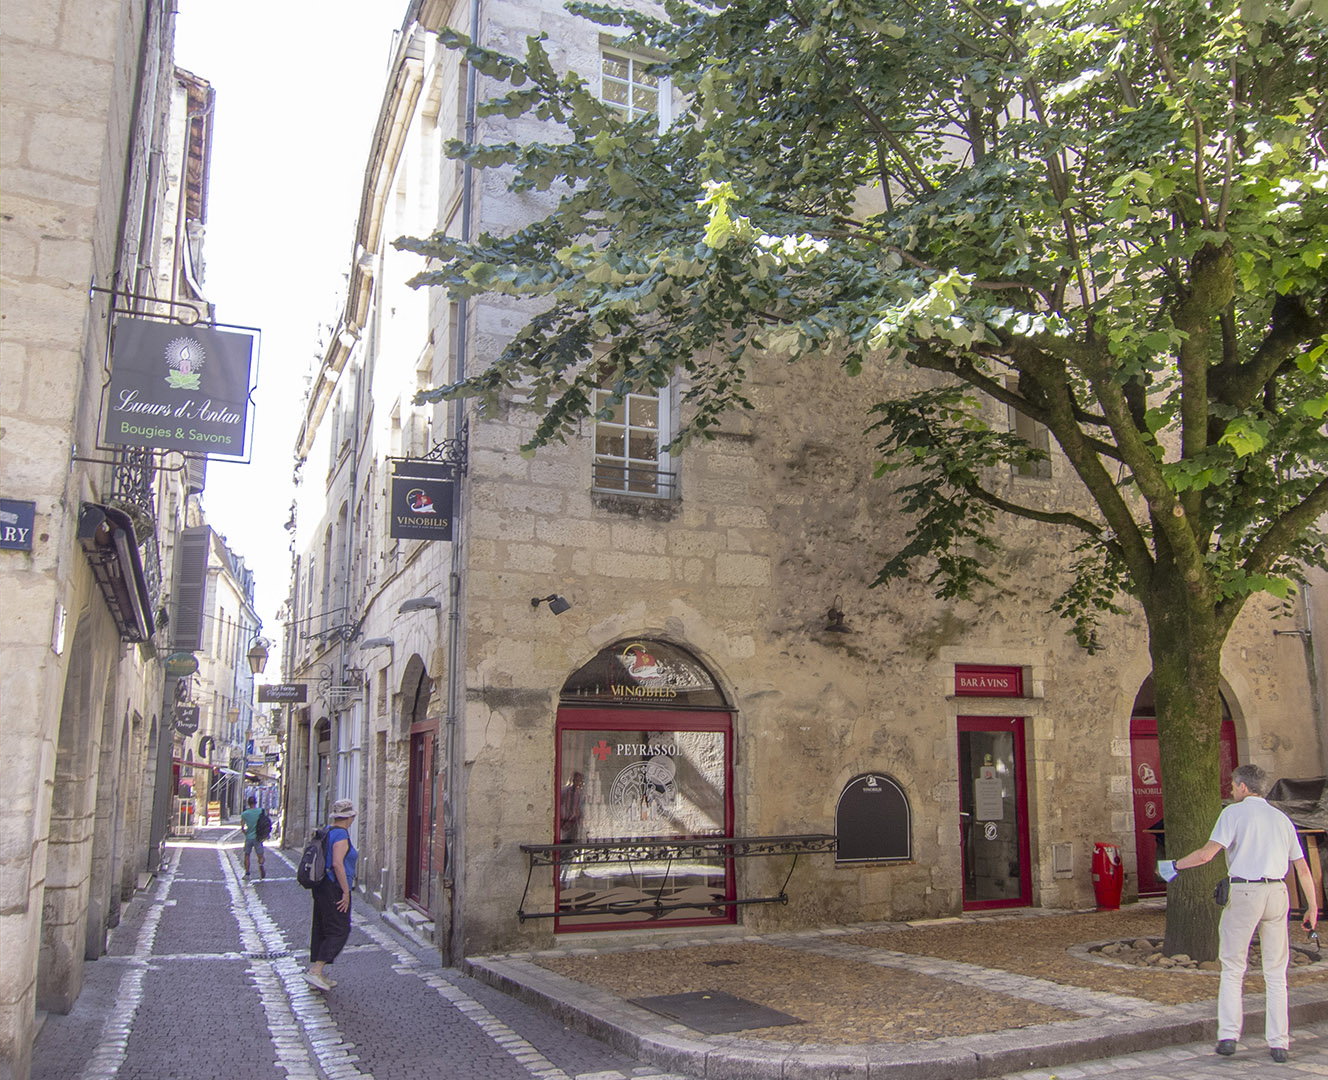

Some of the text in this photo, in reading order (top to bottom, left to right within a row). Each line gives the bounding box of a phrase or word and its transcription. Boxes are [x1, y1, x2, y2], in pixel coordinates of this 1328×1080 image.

[113, 389, 242, 424] Lueurs d'Antan
[121, 421, 232, 444] Bougies & Savons
[397, 516, 448, 527] VINOBILIS
[960, 676, 1009, 688] BAR À VINS
[611, 684, 677, 698] VINOBILIS
[617, 743, 683, 756] PEYRASSOL
